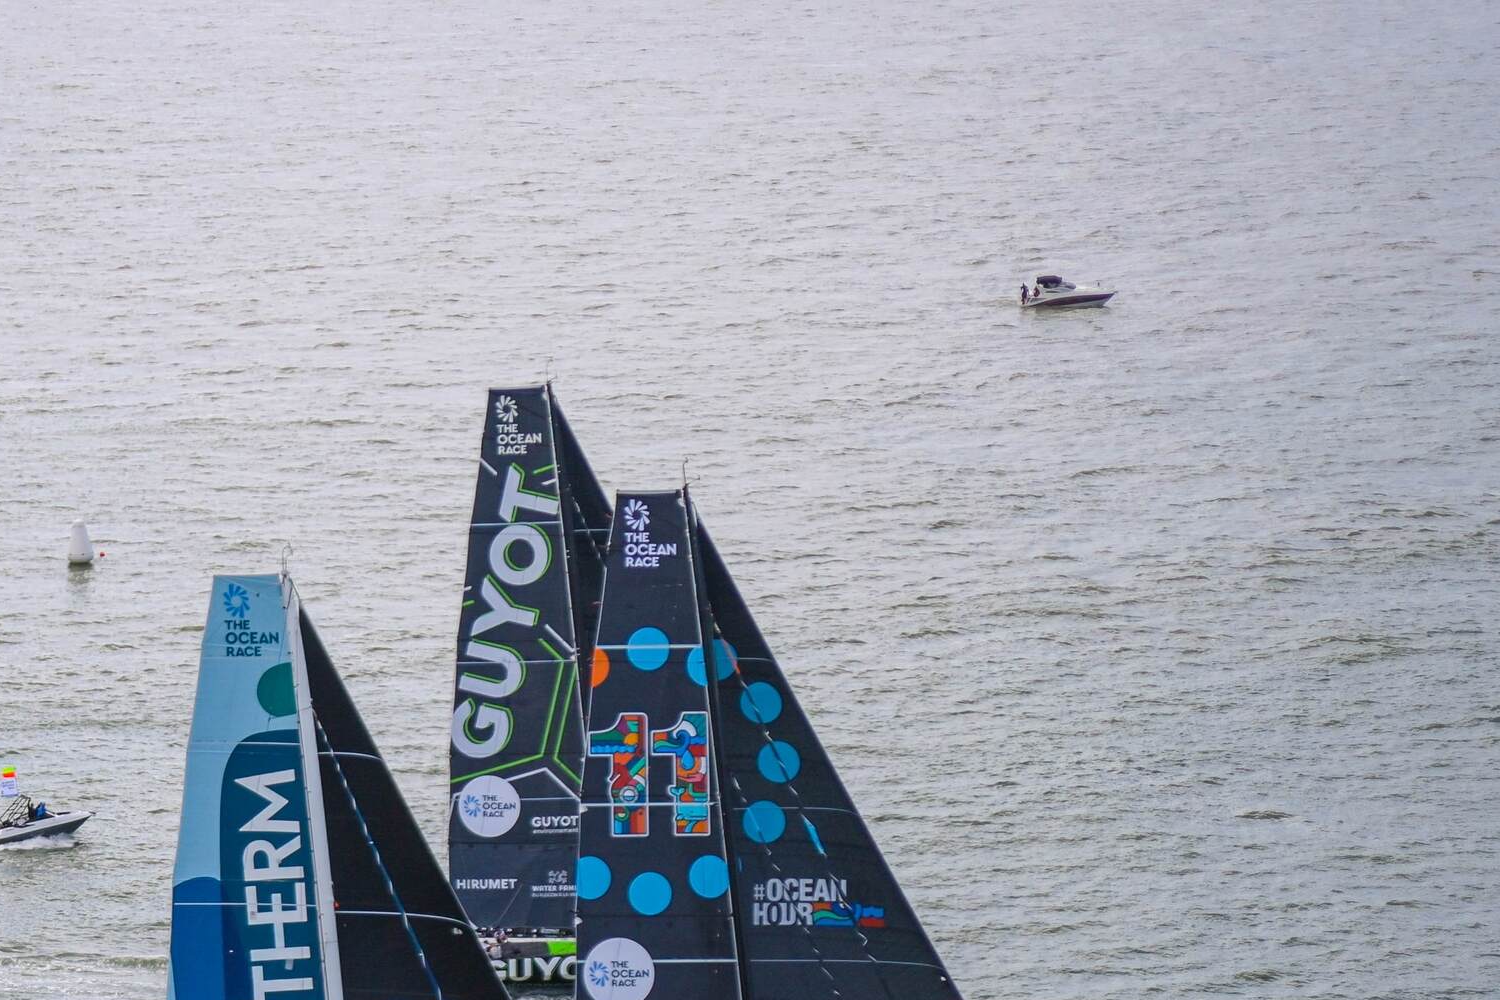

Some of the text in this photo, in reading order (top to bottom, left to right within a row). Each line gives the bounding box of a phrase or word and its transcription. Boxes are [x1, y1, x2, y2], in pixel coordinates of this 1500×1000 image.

[496, 424, 519, 433] THE
[497, 433, 542, 444] OCEAN
[497, 445, 528, 455] RACE
[624, 532, 650, 543] THE
[625, 543, 677, 556] OCEAN
[625, 557, 660, 568] RACE
[451, 463, 559, 759] GUYOT
[224, 620, 251, 630] THE
[225, 631, 279, 644] OCEAN
[226, 646, 262, 657] RACE
[587, 711, 712, 837] 11
[482, 802, 516, 810] OCEAN
[482, 810, 505, 818] RACE
[531, 815, 579, 828] GUYOT
[457, 878, 518, 890] HIRUMET
[753, 902, 813, 926] HOUR
[611, 960, 629, 969] THE
[611, 969, 650, 978] OCEAN
[611, 979, 637, 987] RACE
